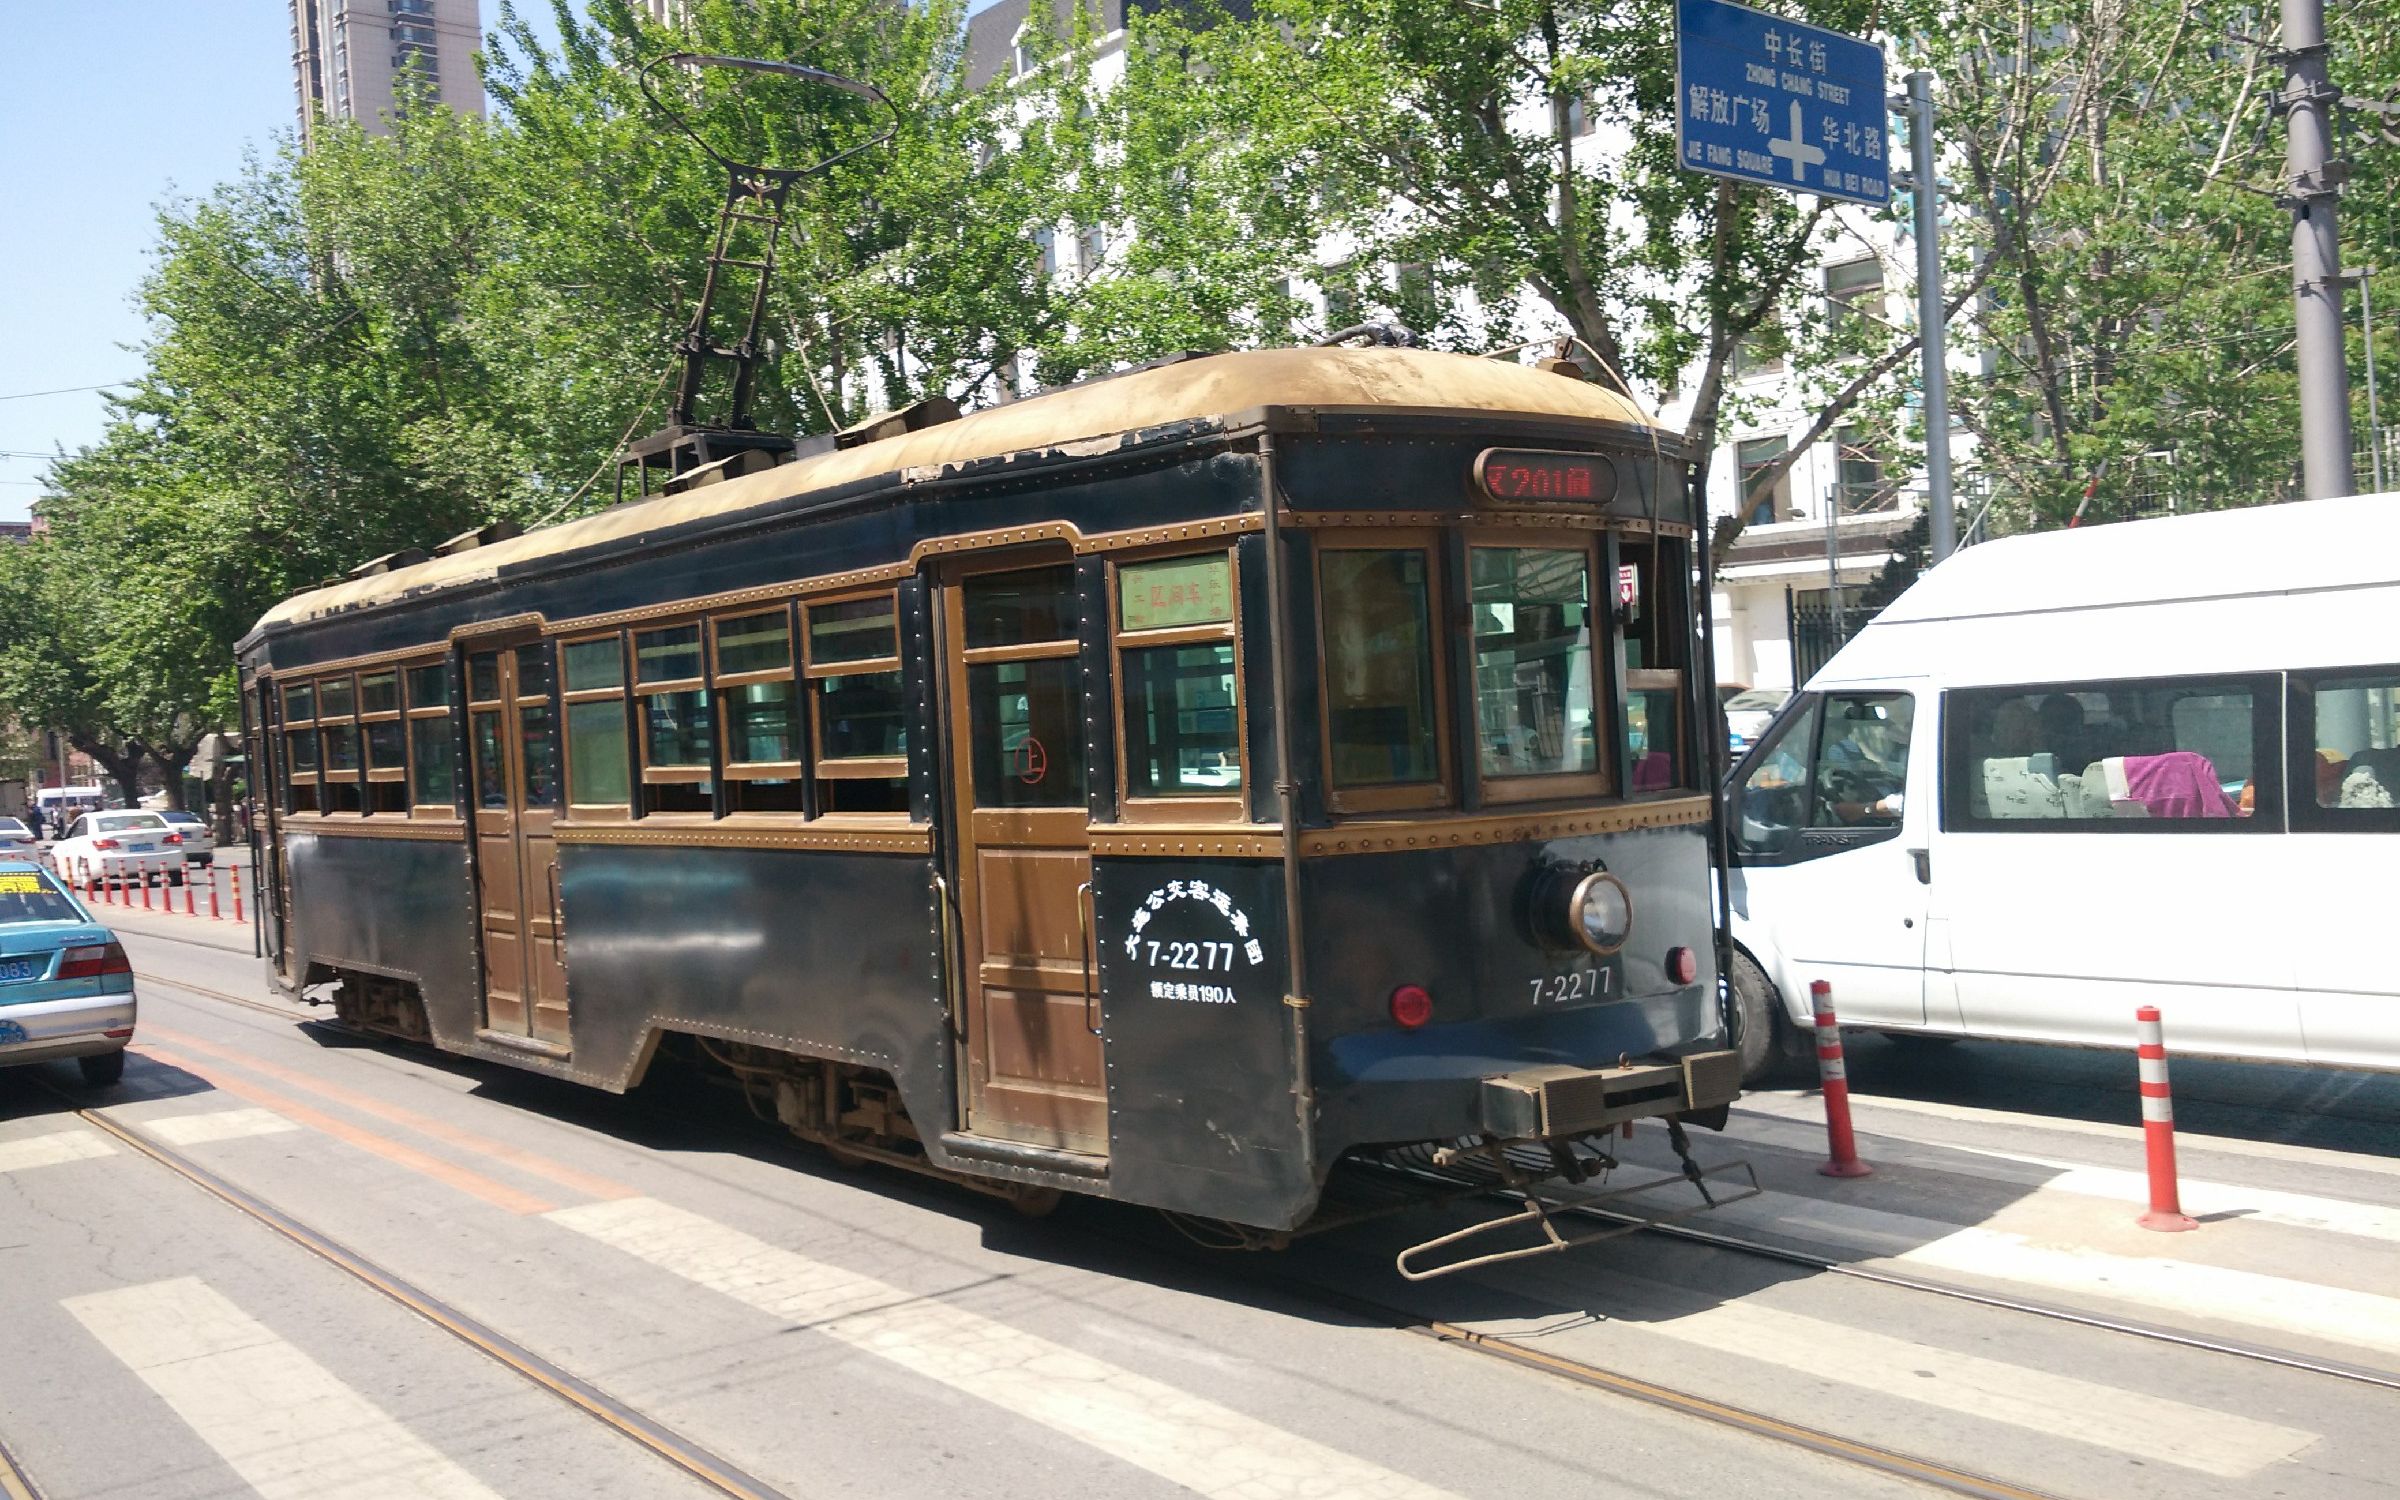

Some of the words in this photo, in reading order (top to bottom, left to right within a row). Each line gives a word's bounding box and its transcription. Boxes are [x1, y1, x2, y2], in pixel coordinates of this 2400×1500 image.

[1764, 28, 1826, 75] 中长街
[1746, 63, 1776, 88] ZHONG
[1781, 72, 1812, 96] CHANG
[1818, 81, 1850, 106] STREET
[1689, 83, 1769, 134] 解放广场
[1822, 115, 1881, 160] 华北路
[1707, 144, 1732, 167] FANG
[1737, 150, 1773, 175] SQUARE
[1862, 177, 1885, 197] ROAD
[1147, 941, 1234, 972] 7-2277
[1530, 966, 1610, 1005] 7-2277
